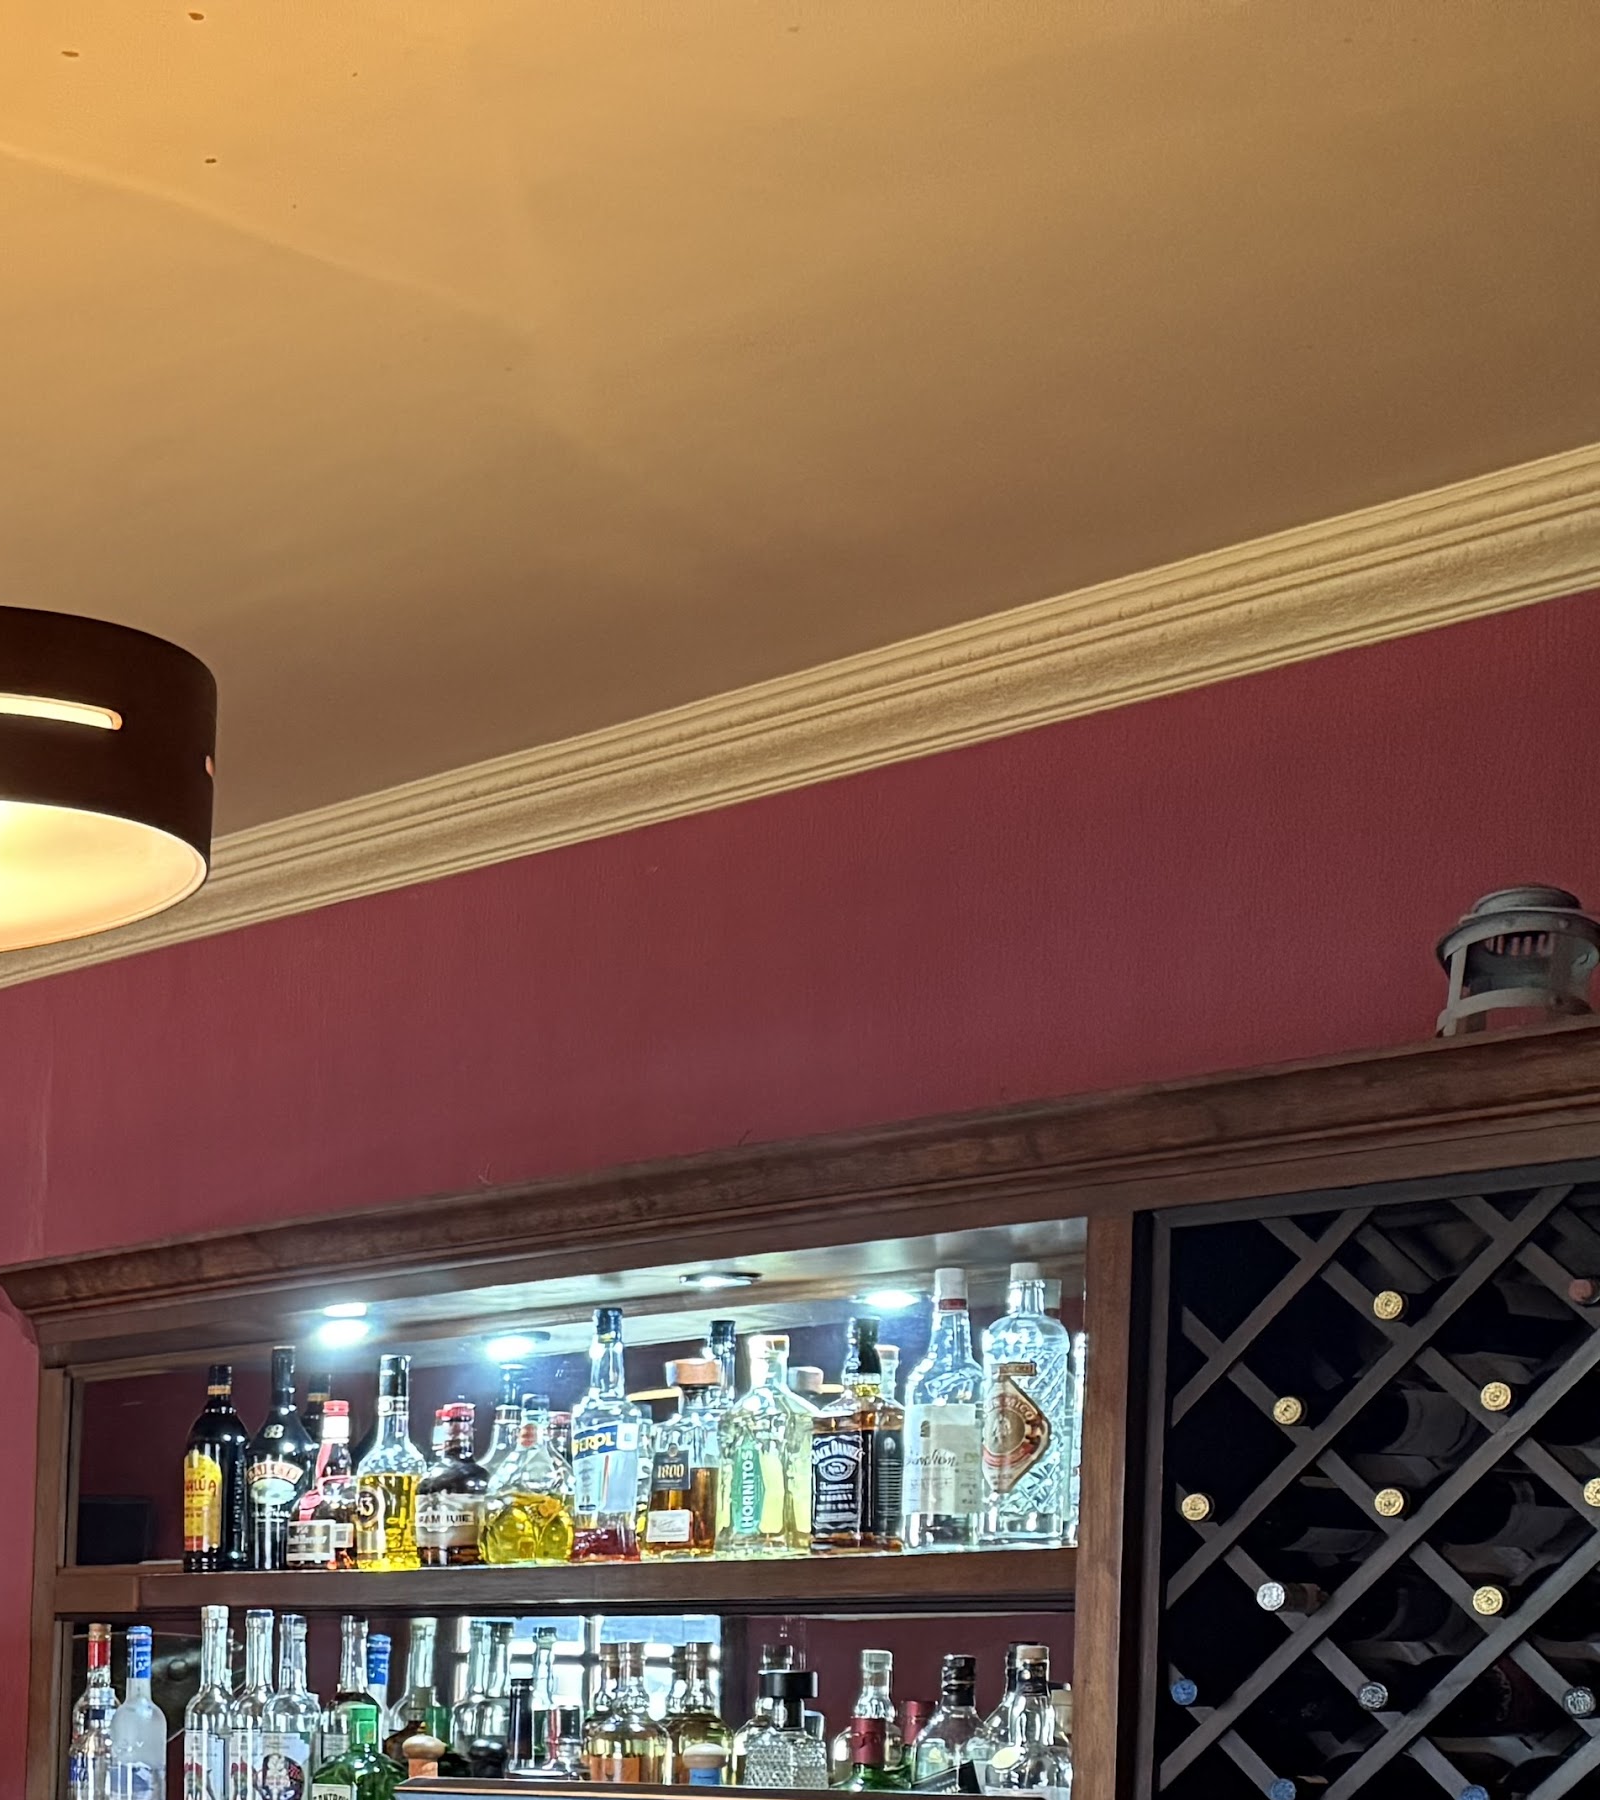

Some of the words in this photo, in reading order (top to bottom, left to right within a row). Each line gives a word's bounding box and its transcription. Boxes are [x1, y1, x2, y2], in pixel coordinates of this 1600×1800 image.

[571, 1432, 616, 1456] PEROL
[657, 1464, 685, 1479] 1800
[742, 1450, 755, 1529] HORNITOS
